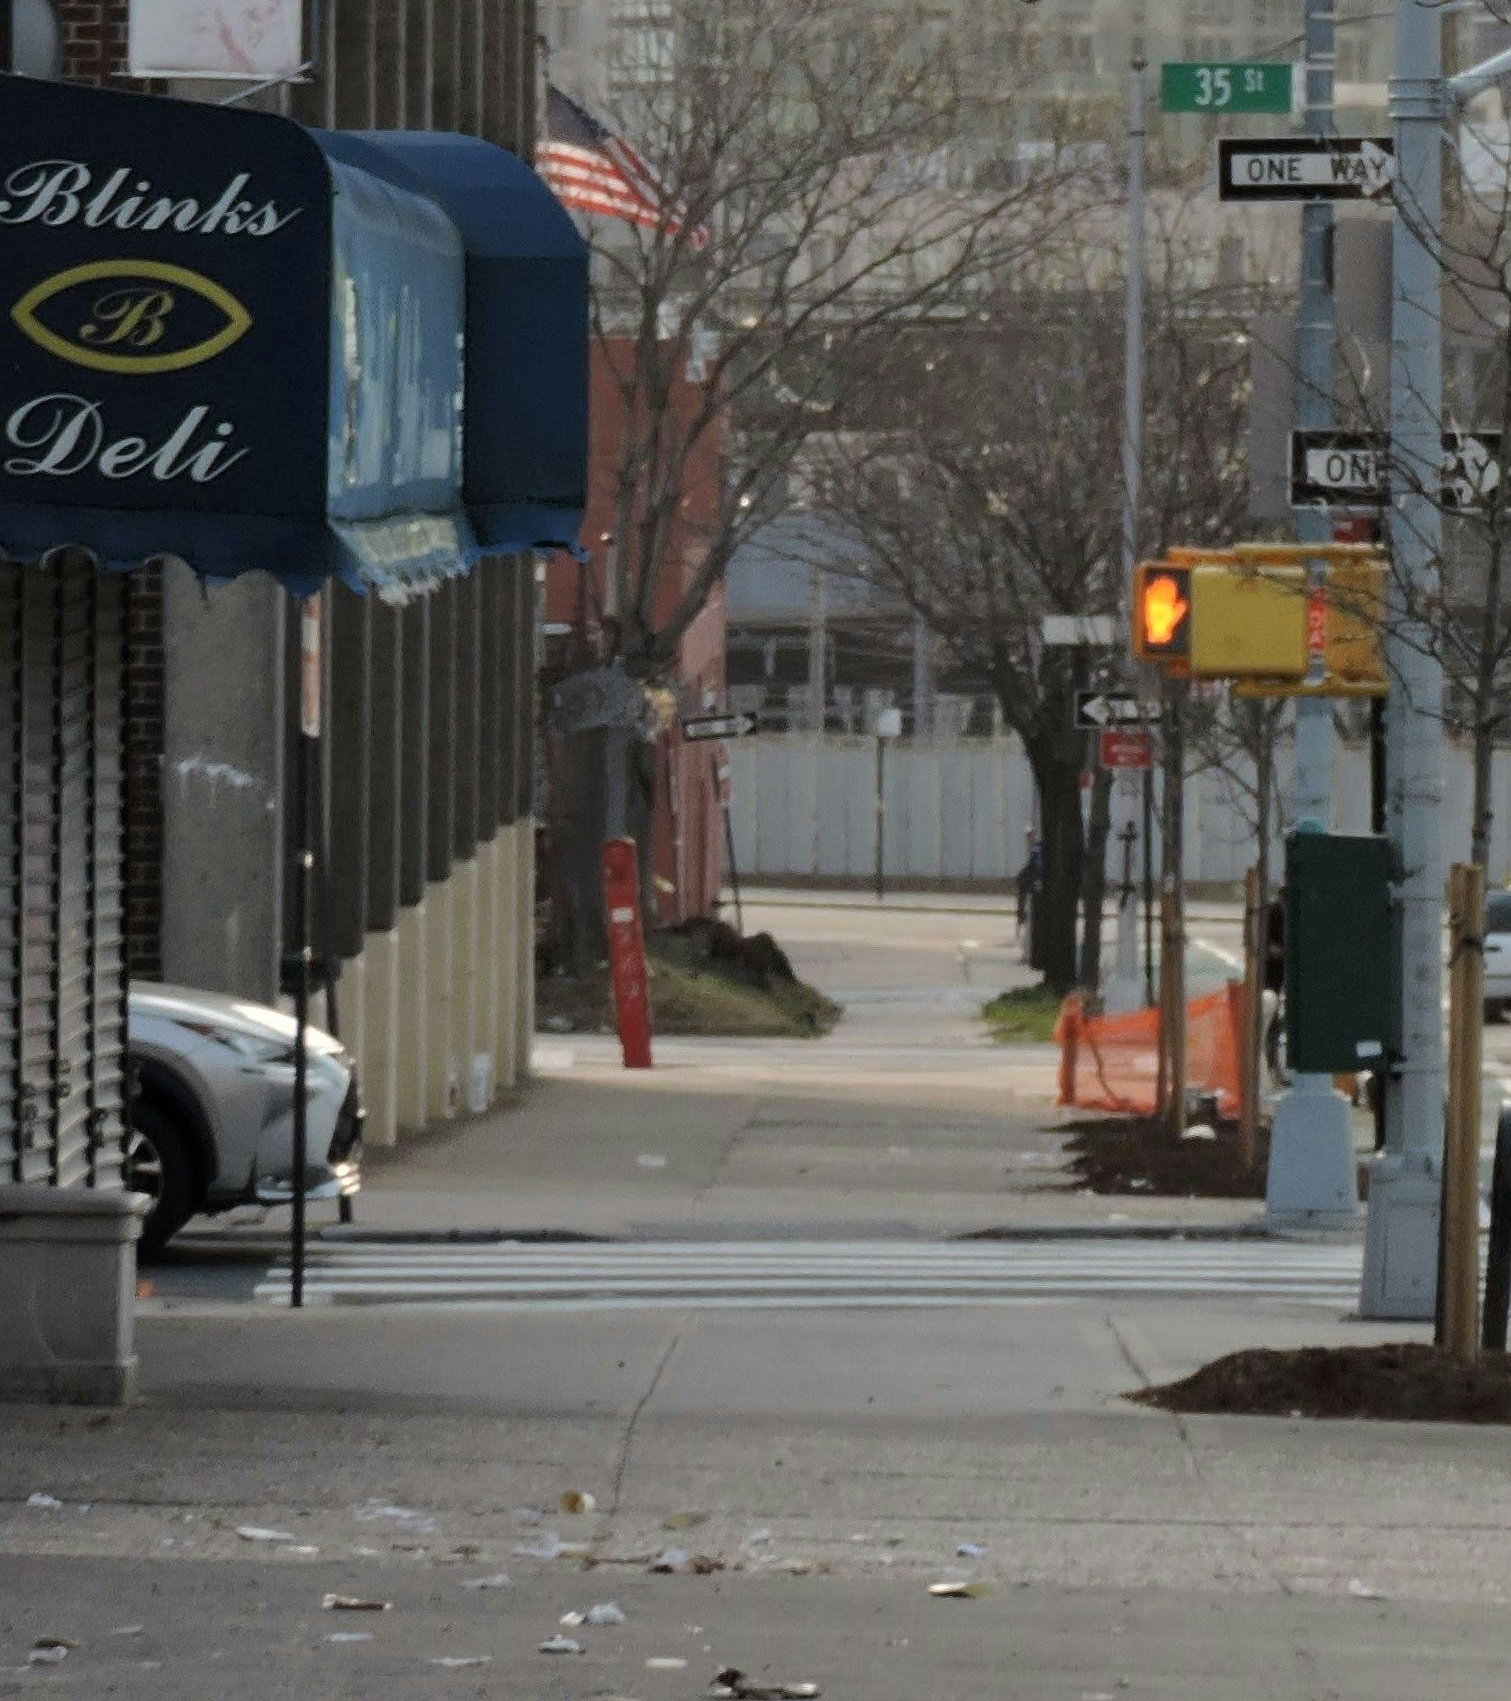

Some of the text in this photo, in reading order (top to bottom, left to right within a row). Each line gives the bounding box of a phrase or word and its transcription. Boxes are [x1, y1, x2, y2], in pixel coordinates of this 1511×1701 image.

[1192, 66, 1232, 106] 35
[0, 159, 304, 236] Blinks
[1248, 155, 1386, 182] ONE WAY
[3, 392, 251, 483] Deli
